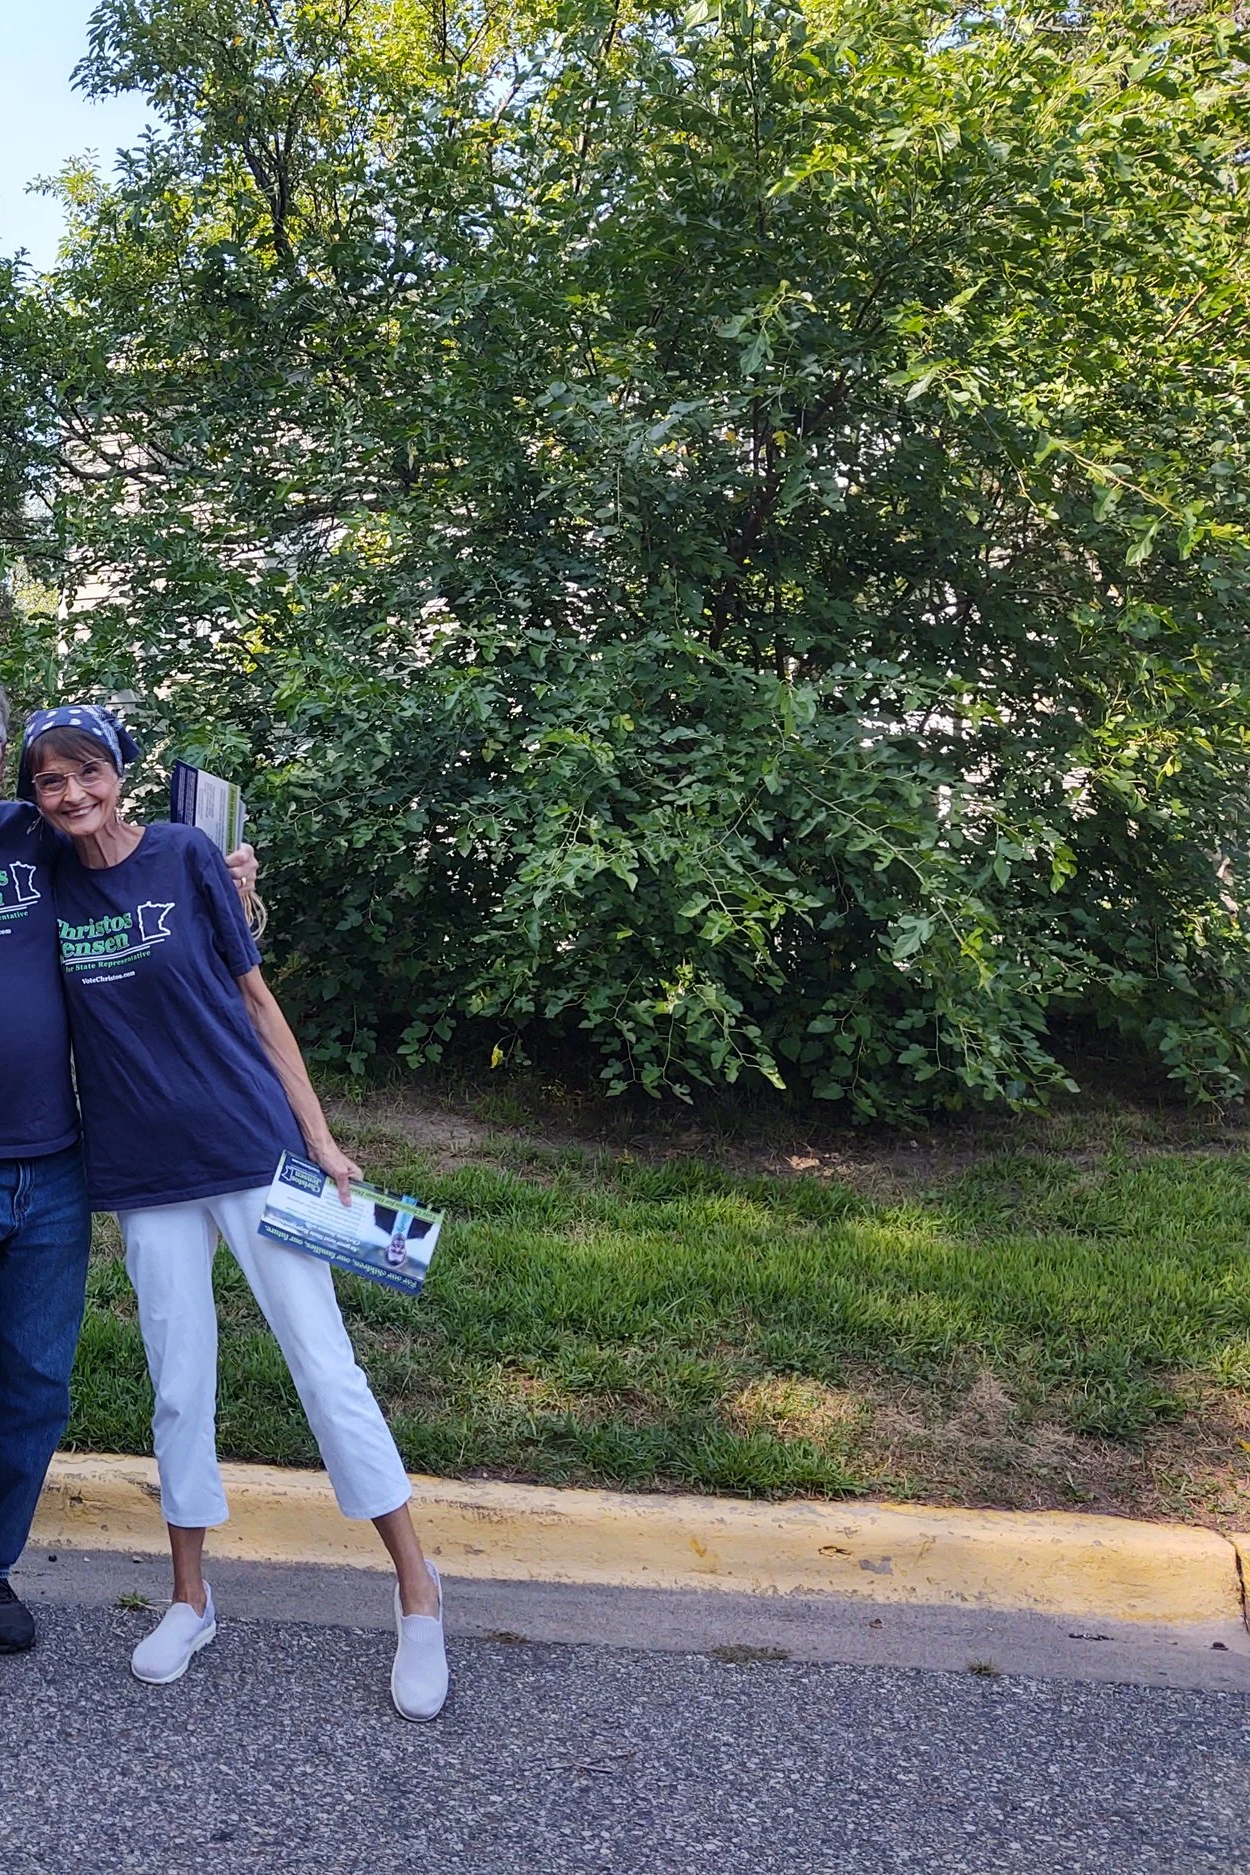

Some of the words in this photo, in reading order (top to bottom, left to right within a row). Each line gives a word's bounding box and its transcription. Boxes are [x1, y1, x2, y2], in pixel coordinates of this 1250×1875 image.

[60, 933, 130, 963] ensen
[75, 961, 96, 971] State
[98, 950, 151, 969] Representative
[82, 971, 136, 985] VoteChristos.com
[264, 1225, 289, 1241] future.
[289, 1236, 303, 1246] our
[336, 1253, 351, 1263] our
[386, 1272, 402, 1282] our
[400, 1278, 418, 1289] For
